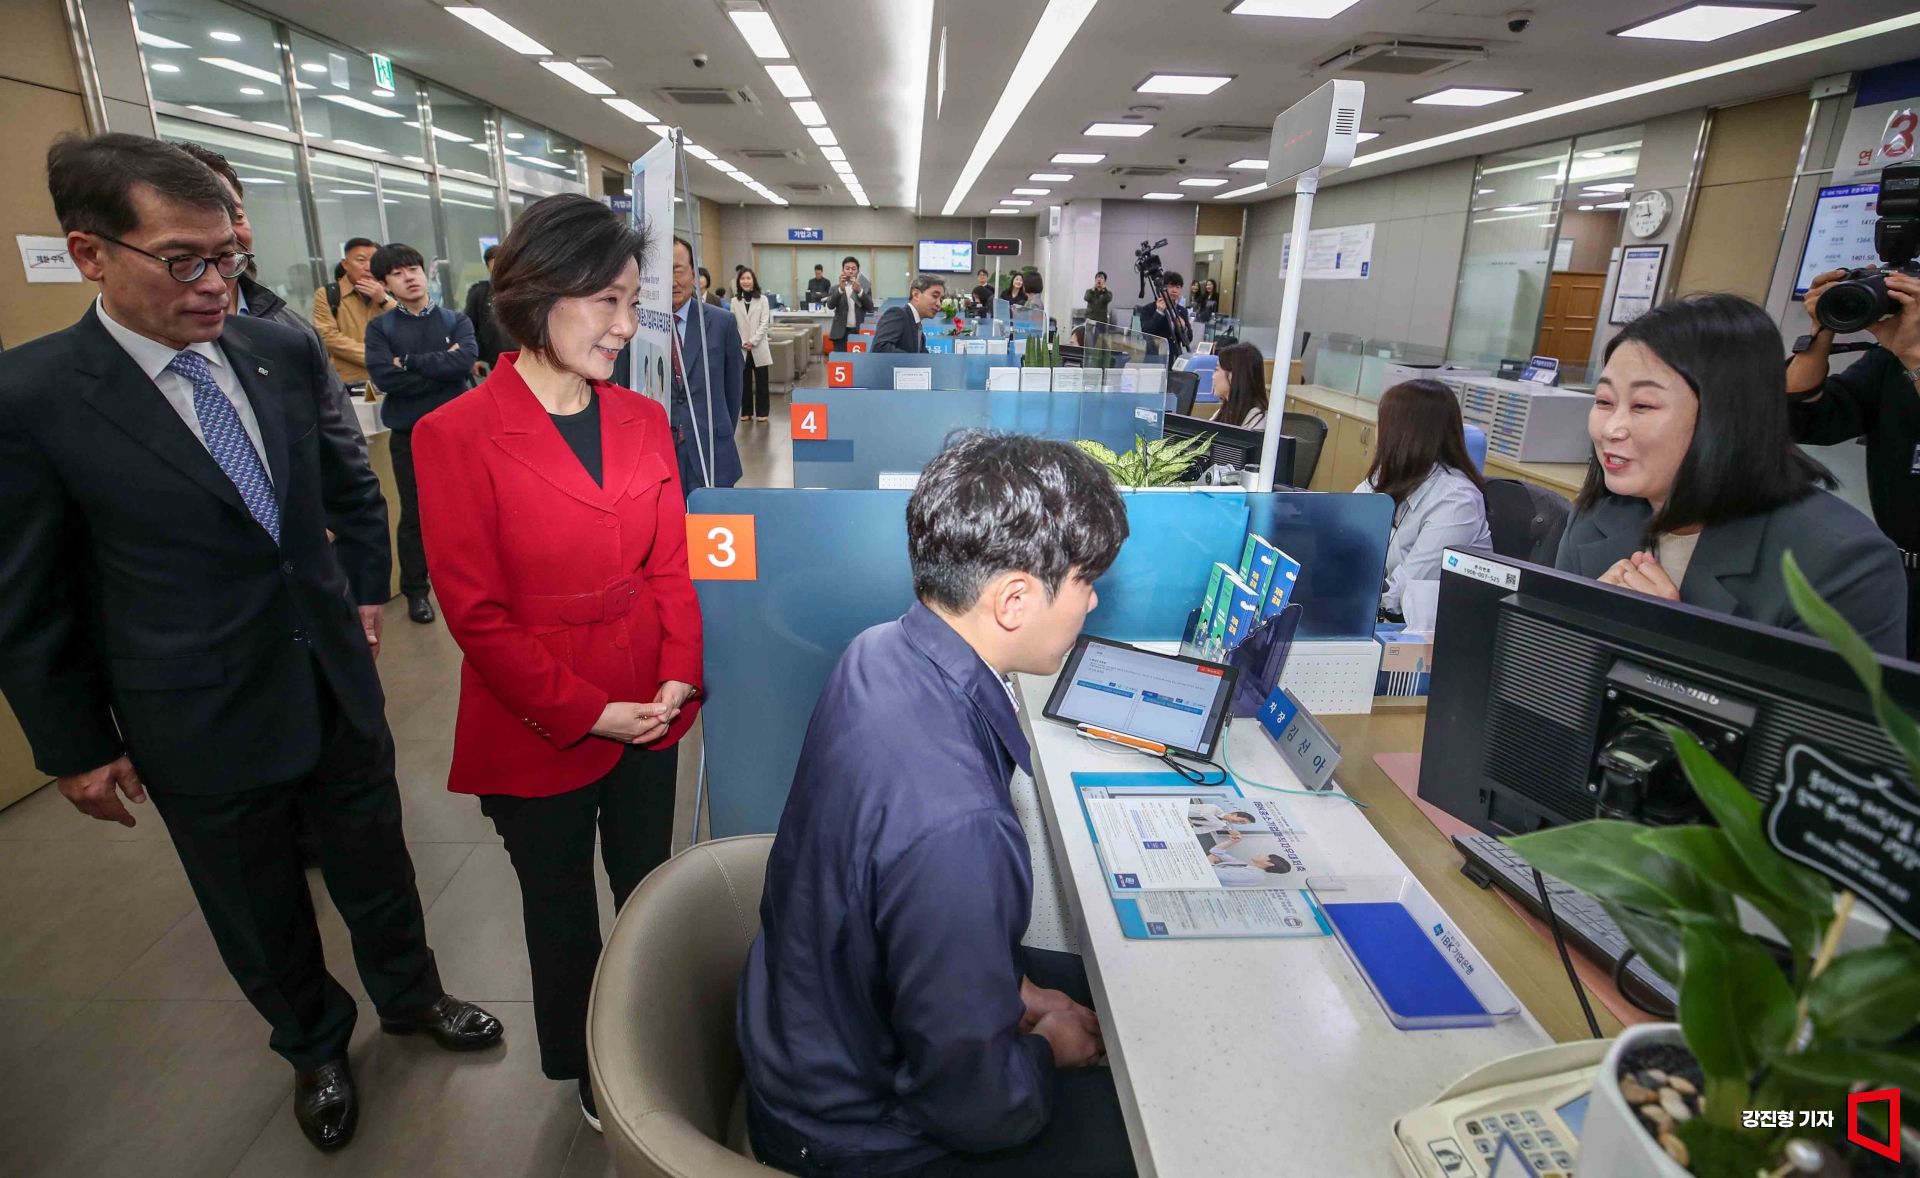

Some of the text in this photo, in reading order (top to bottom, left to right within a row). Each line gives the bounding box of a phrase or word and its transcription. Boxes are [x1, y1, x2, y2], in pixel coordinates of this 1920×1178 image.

[1858, 148, 1873, 166] 연
[794, 230, 818, 239] 기업고객
[834, 366, 846, 383] 5
[800, 411, 818, 434] 4
[707, 526, 737, 568] 3
[1644, 674, 1720, 705] SAMSUNG
